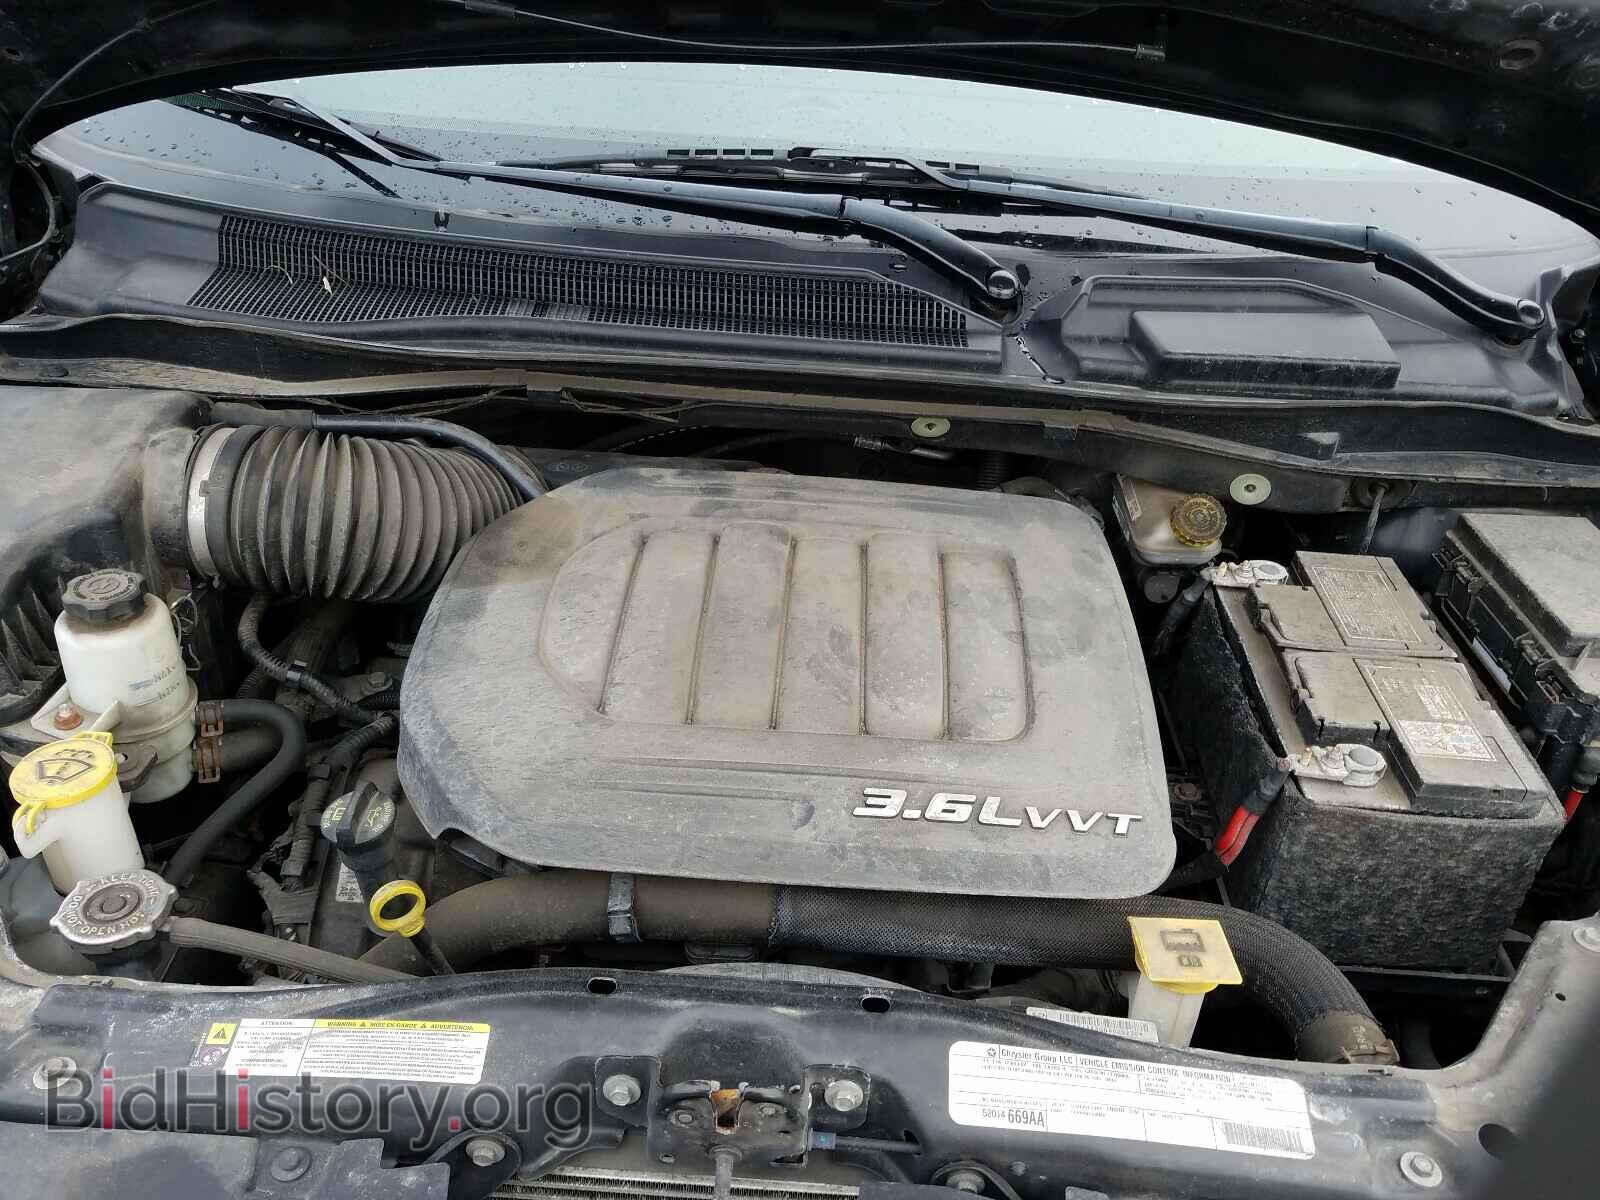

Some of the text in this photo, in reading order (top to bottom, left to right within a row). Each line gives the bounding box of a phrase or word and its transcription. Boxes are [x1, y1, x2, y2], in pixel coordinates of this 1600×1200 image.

[80, 925, 116, 935] OPEN
[1001, 1048, 1073, 1065] Chrysler Group LLC
[1079, 1057, 1109, 1069] VEHICLE
[1008, 1109, 1045, 1127] 669AA
